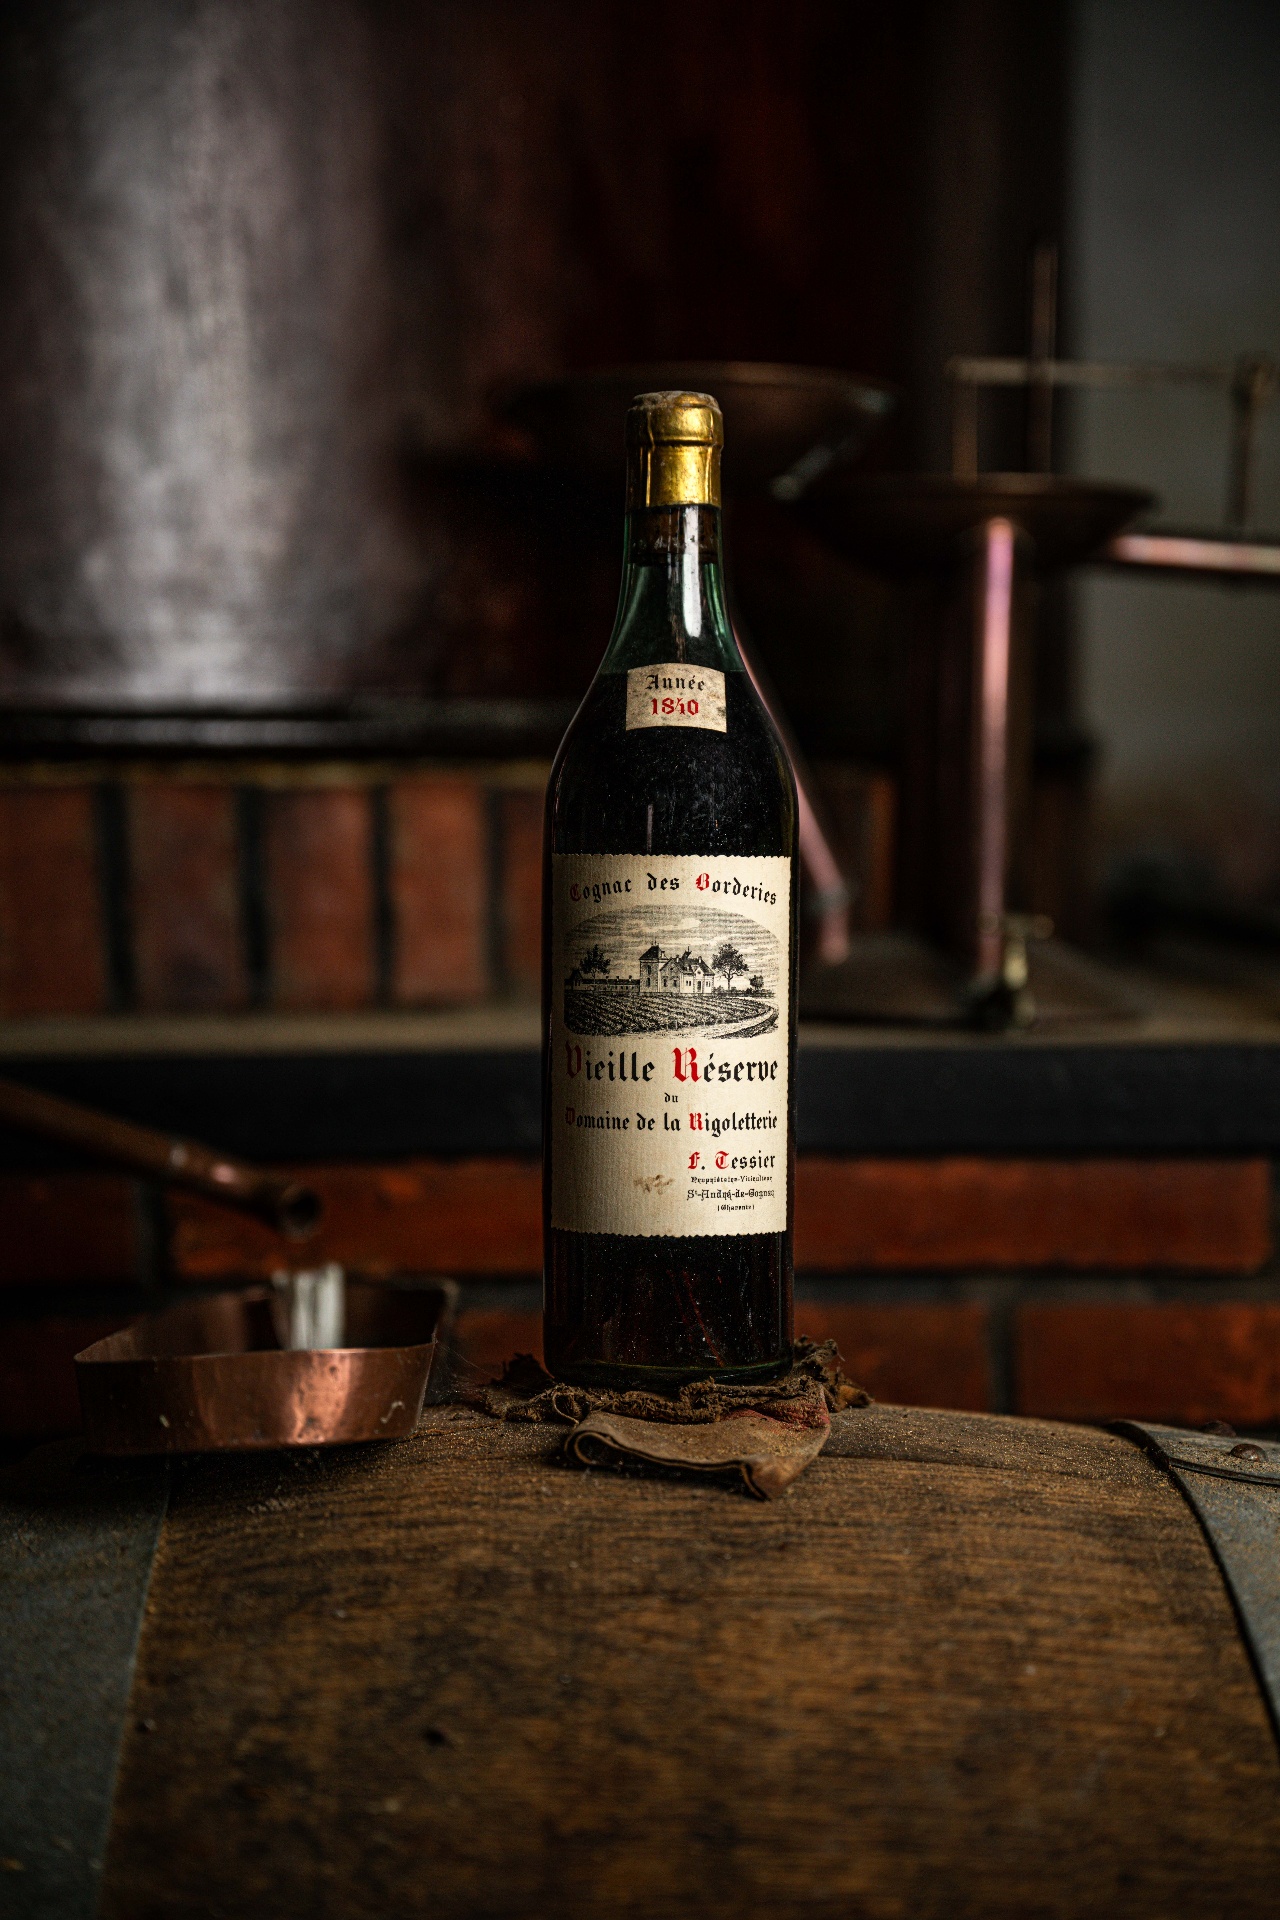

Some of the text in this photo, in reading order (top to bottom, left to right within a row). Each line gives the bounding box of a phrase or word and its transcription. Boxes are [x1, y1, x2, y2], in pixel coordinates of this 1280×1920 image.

[645, 674, 705, 691] Année
[569, 872, 777, 905] Cognac des Borderies
[565, 1041, 778, 1083] Vieille Réserve
[664, 1092, 679, 1103] du
[565, 1106, 778, 1138] Domaine de la Rigoletterie
[687, 1149, 776, 1171] F. Tessier
